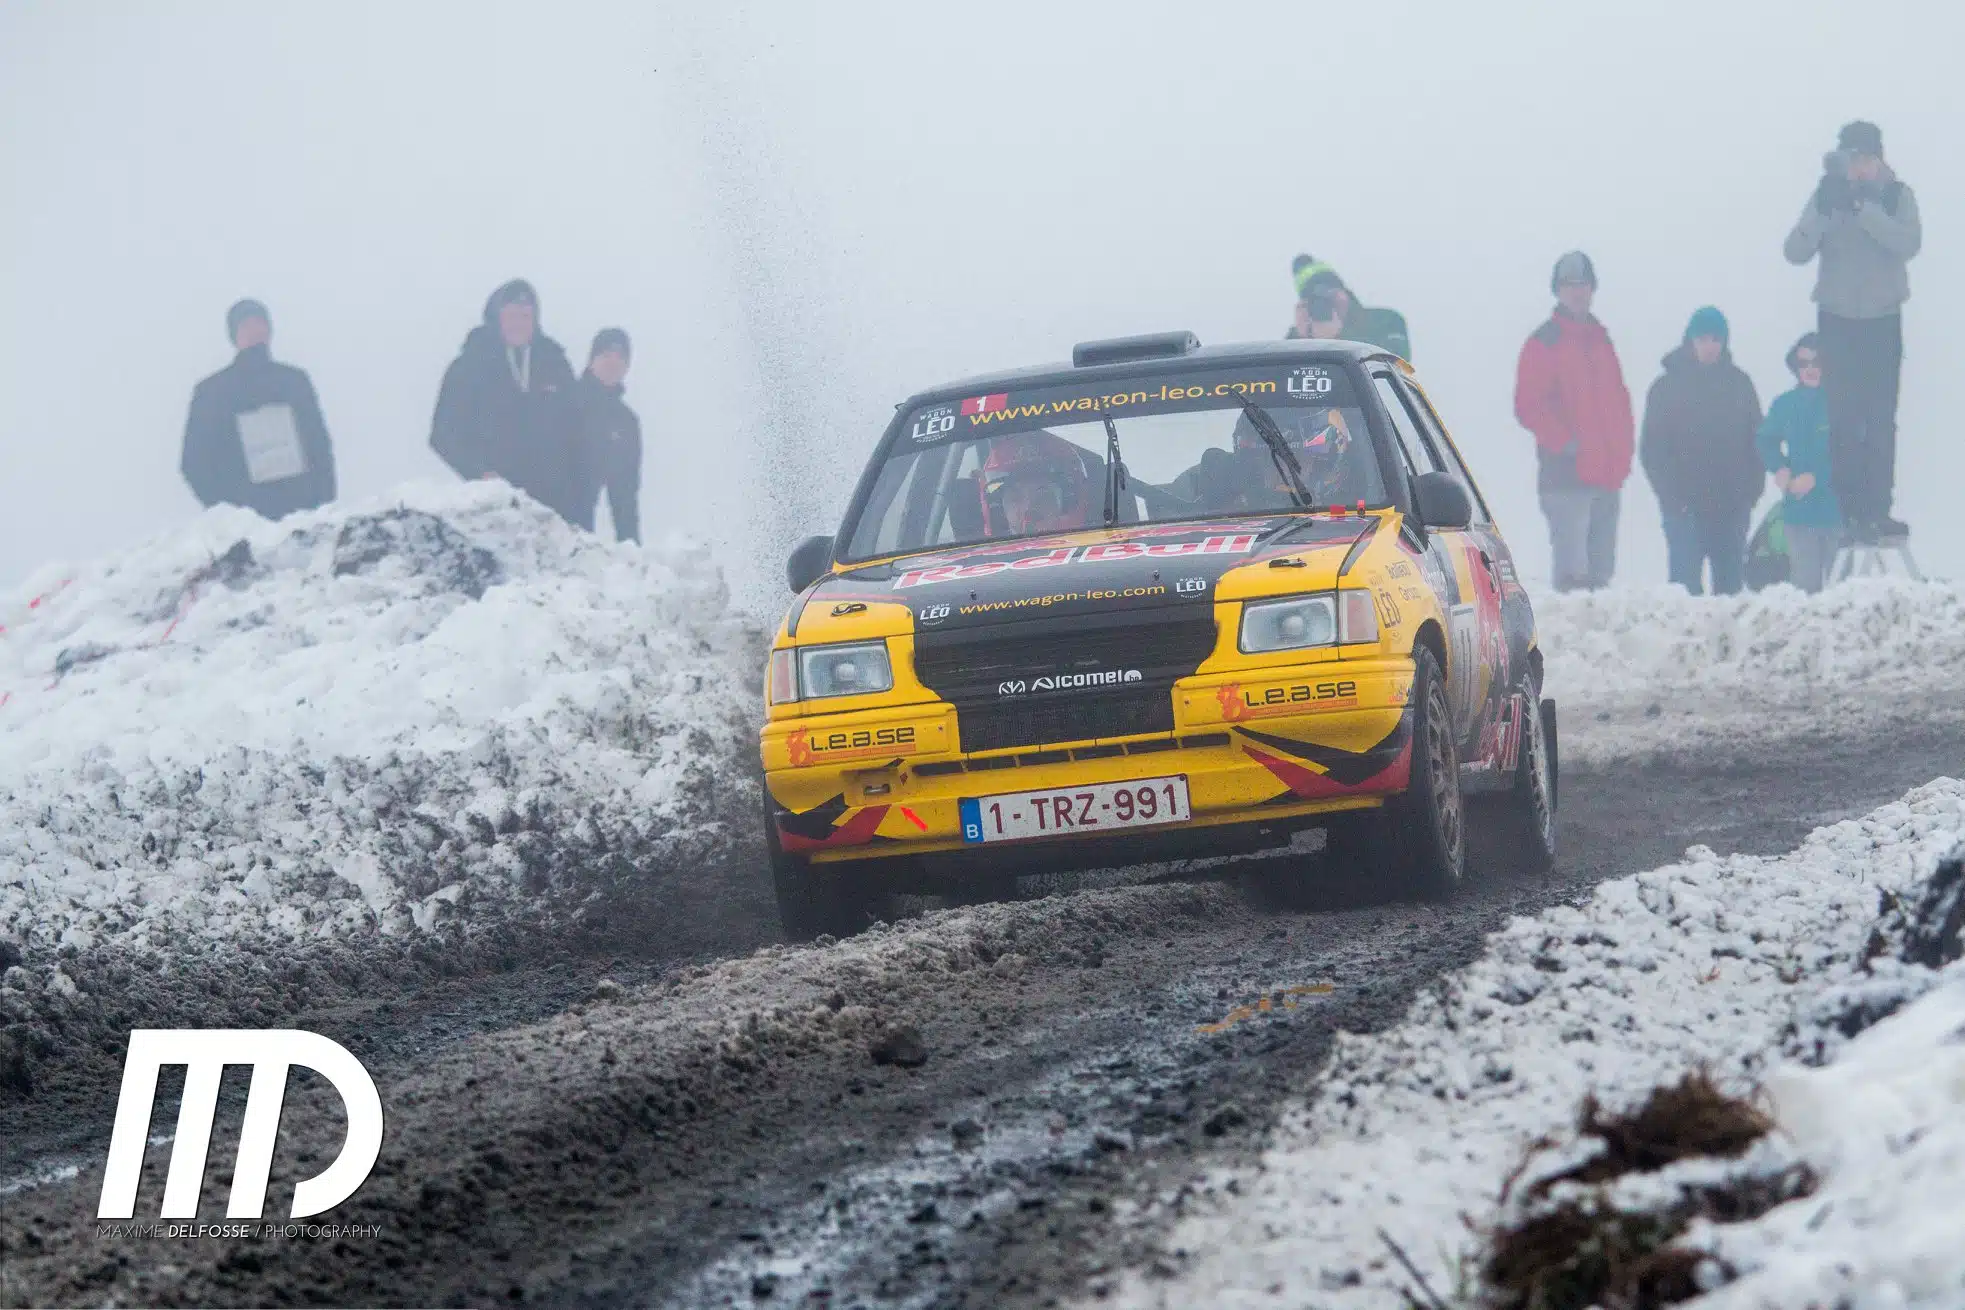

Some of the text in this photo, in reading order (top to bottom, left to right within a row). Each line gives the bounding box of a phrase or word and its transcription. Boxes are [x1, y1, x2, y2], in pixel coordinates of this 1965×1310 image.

[976, 396, 987, 412] 1
[893, 534, 1258, 590] Red Bull
[959, 585, 1165, 615] www.wagon-leo.com
[1031, 669, 1123, 692] Alcomel
[966, 824, 979, 839] B
